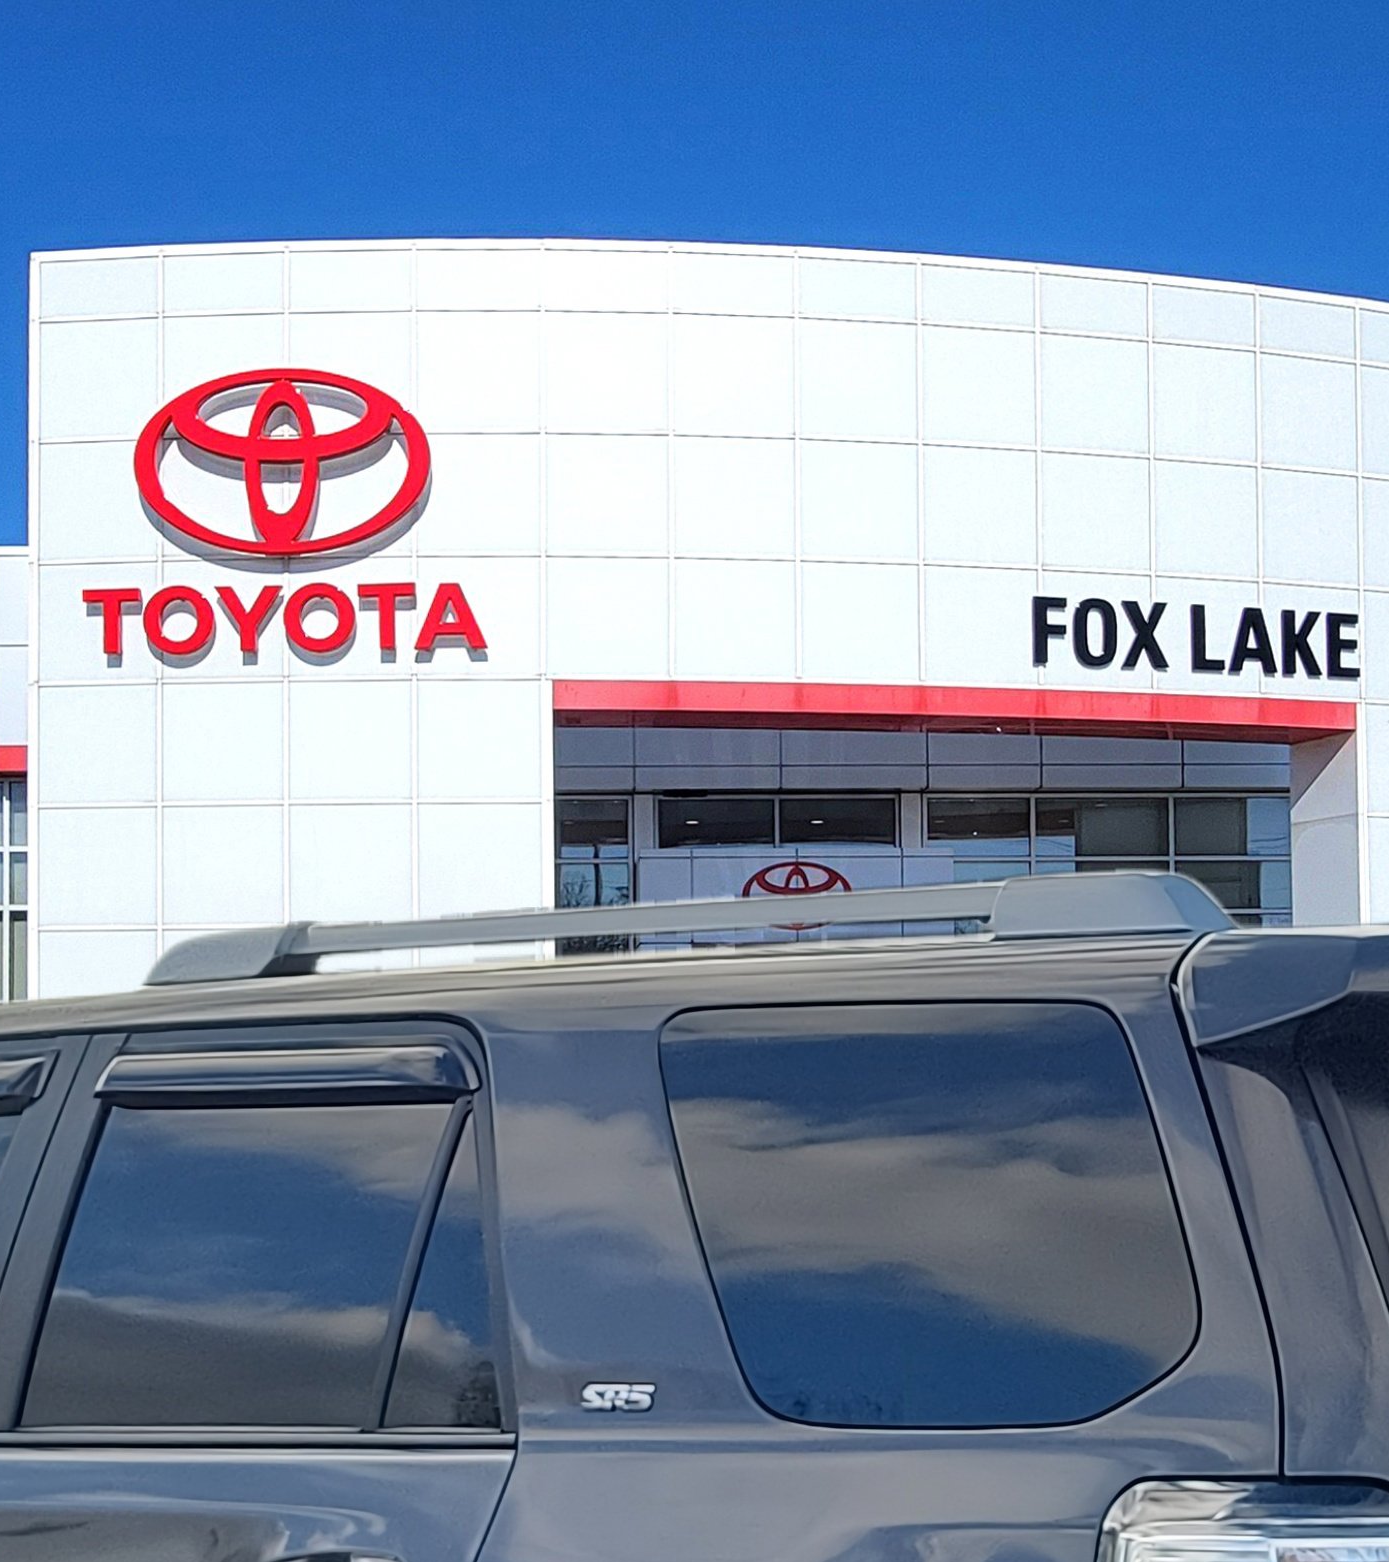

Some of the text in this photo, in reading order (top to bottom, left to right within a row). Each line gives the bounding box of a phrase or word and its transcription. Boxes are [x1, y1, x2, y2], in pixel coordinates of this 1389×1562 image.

[82, 583, 489, 660] TOYOTA
[1032, 595, 1361, 679] FOX LAKE
[580, 1382, 657, 1412] SR5
